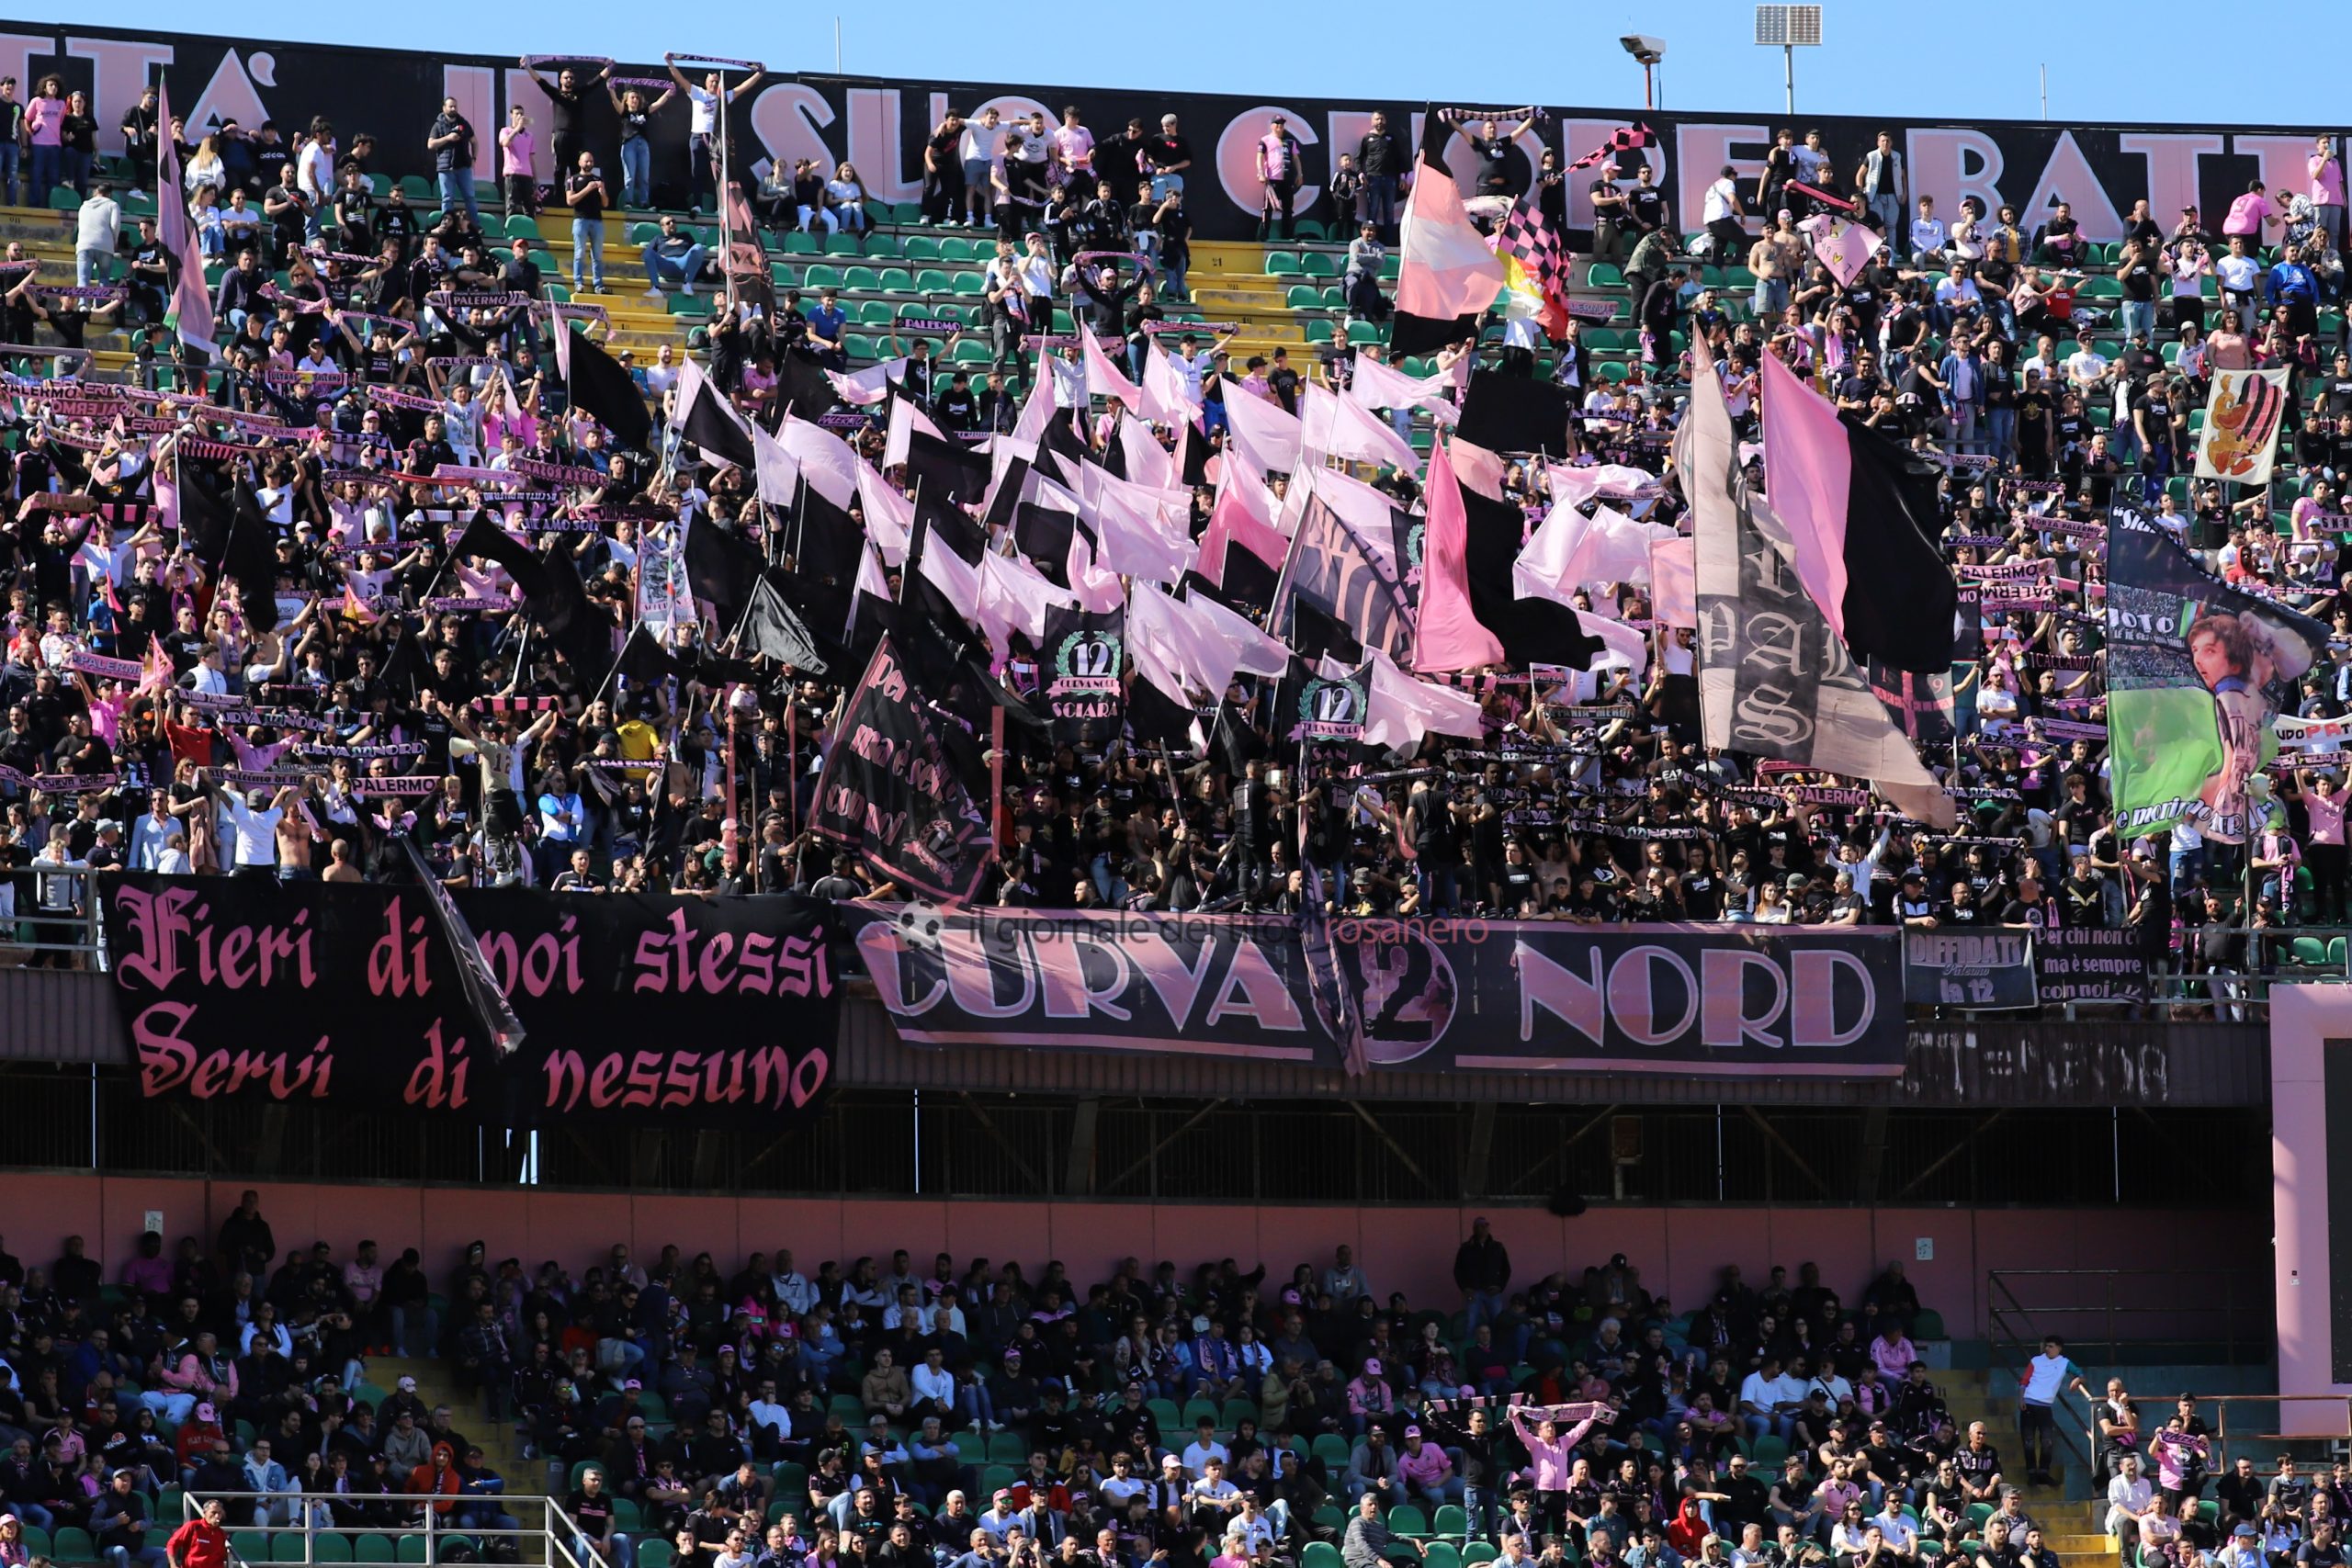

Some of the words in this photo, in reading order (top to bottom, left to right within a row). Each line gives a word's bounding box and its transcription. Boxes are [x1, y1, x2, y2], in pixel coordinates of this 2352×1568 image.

[1906, 128, 2352, 245] BATT
[453, 295, 508, 305] PALERMO
[905, 320, 960, 332] PALERMO
[435, 357, 492, 366] PALERMO
[2031, 519, 2057, 530] FORZA
[2062, 524, 2100, 535] PALERMO
[1074, 642, 1109, 675] 12
[1052, 701, 1118, 718] SCIARA
[1317, 689, 1351, 722] 12
[353, 778, 435, 793] PALERMO
[1794, 787, 1866, 806] PALERMO
[1648, 828, 1695, 840] NORD
[116, 884, 317, 991] Fieri
[368, 894, 433, 998] di
[476, 915, 584, 998] noi
[633, 907, 833, 999] stessi
[2035, 928, 2064, 945] Per
[2067, 926, 2089, 945] chi
[2092, 930, 2122, 945] non
[1909, 935, 2022, 964] DIFFIDATI
[2044, 958, 2070, 974] ma
[2072, 953, 2081, 973] è
[2083, 957, 2142, 976] sempre
[856, 920, 1308, 1034] CURVA
[1515, 939, 1876, 1048] NORD
[1939, 978, 1964, 1003] la
[1968, 978, 1996, 1003] 12
[2041, 985, 2075, 998] con
[2079, 981, 2109, 998] noi
[132, 1001, 334, 1100] Servi
[403, 1017, 469, 1111] di
[542, 1045, 828, 1113] nessuno
